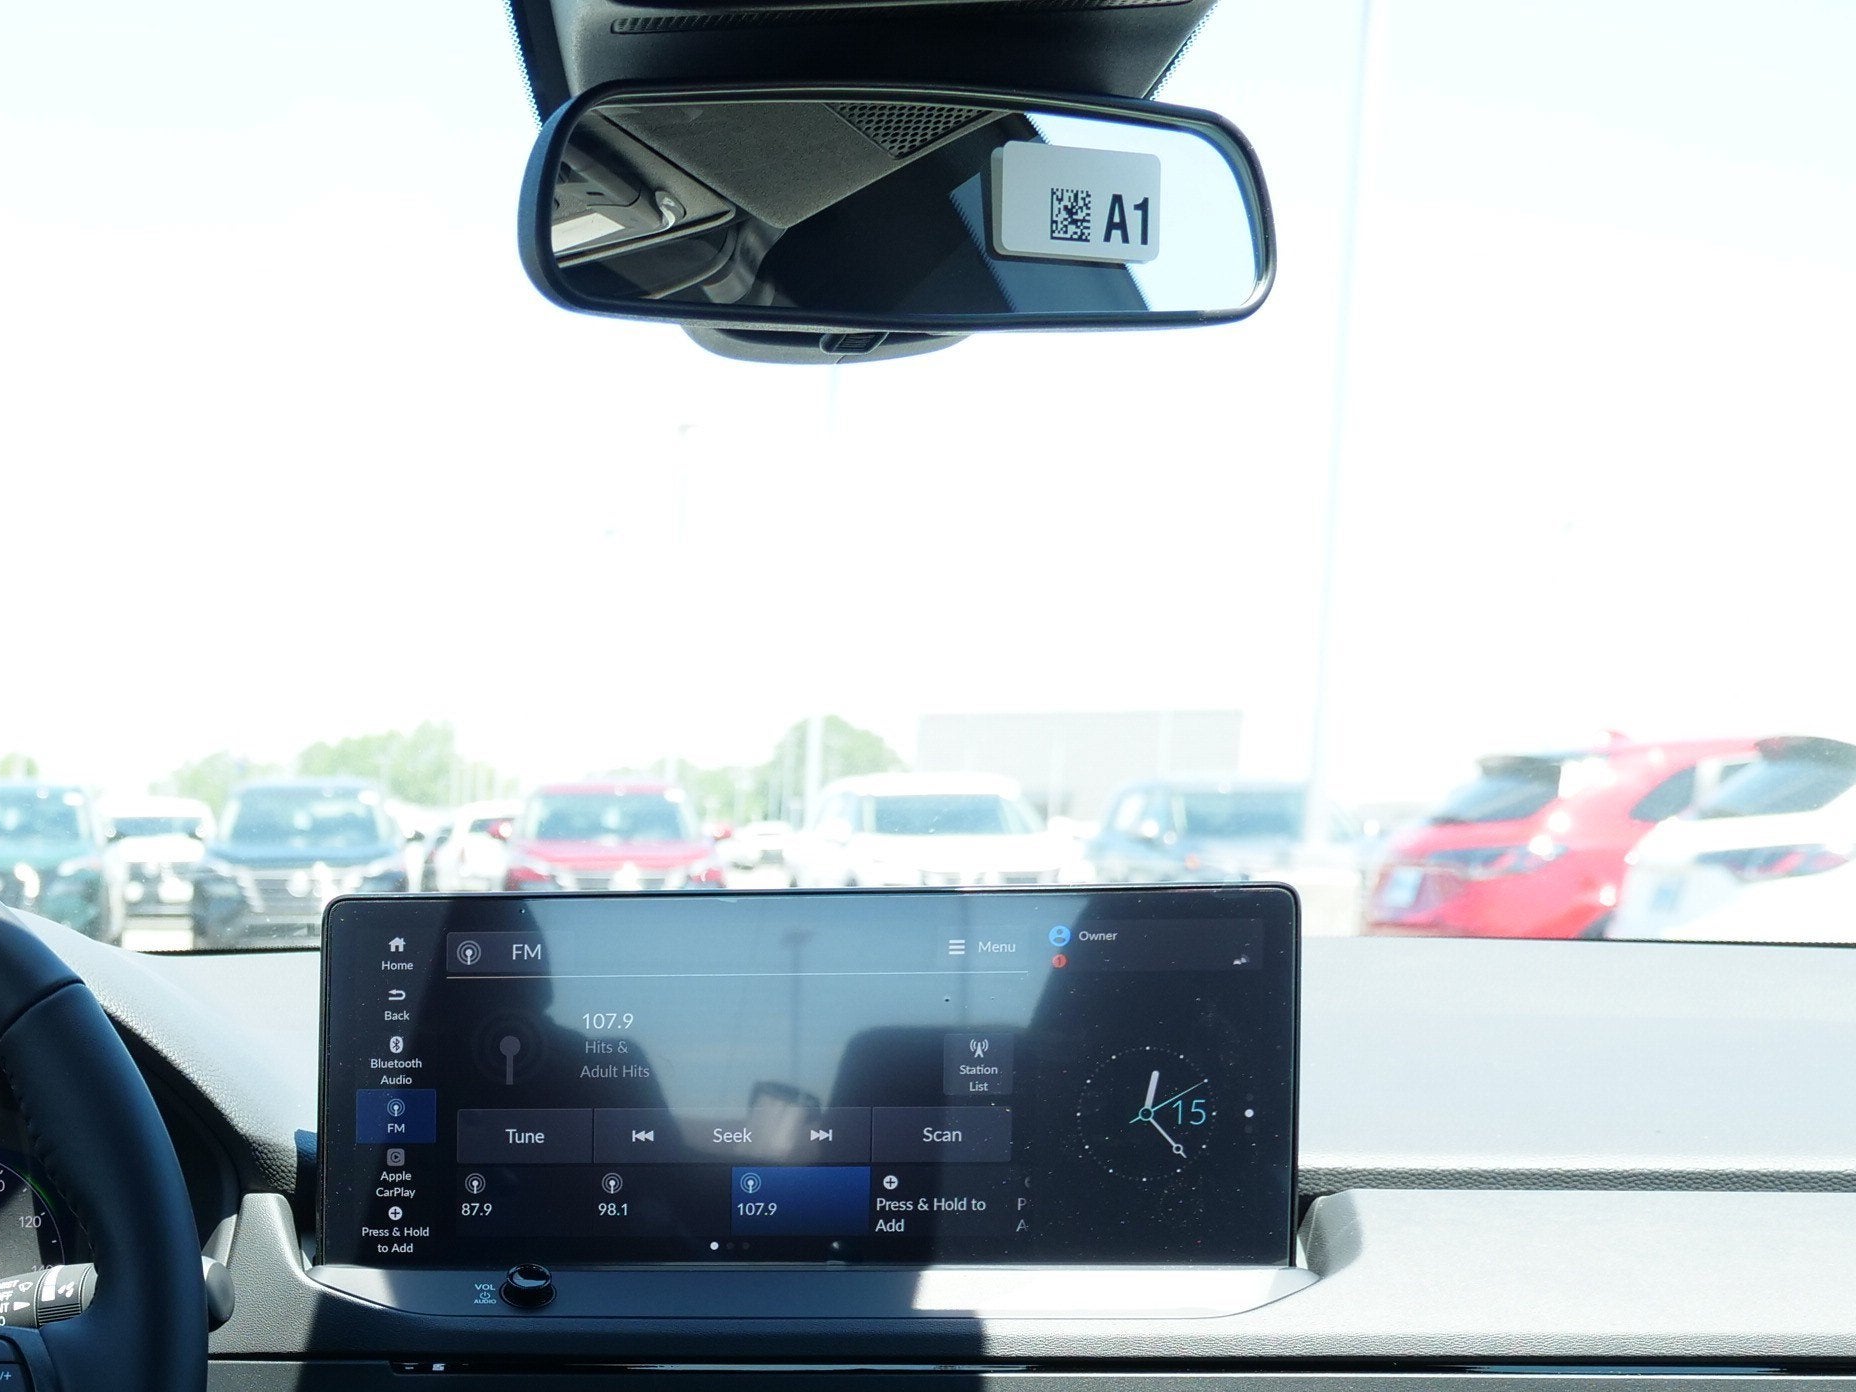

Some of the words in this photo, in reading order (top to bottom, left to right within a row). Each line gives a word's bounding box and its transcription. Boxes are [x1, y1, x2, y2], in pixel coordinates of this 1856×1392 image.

[1103, 193, 1149, 245] A1
[1078, 931, 1118, 941] Owner
[512, 944, 541, 960] FM
[978, 941, 1016, 953] Menu
[381, 961, 413, 970] Home
[384, 1011, 409, 1021] Back
[582, 1013, 634, 1029] 107.9
[585, 1041, 615, 1054] Hits
[617, 1042, 629, 1054] &
[370, 1058, 422, 1069] Bluetooth
[959, 1064, 998, 1075] Station
[580, 1065, 618, 1078] Adult
[622, 1065, 649, 1078] Hits
[380, 1075, 412, 1085] Audio
[969, 1081, 989, 1092] List
[1172, 1099, 1206, 1125] 15
[387, 1124, 405, 1133] FM
[922, 1127, 962, 1143] Scan
[506, 1129, 544, 1144] Tune
[713, 1128, 753, 1143] Seek
[380, 1171, 412, 1182] Apple
[376, 1187, 416, 1199] CarPlay
[461, 1203, 492, 1216] 87.9
[598, 1203, 628, 1216] 98.1
[737, 1203, 777, 1216] 107.9
[876, 1198, 913, 1212] Press
[918, 1199, 929, 1211] &
[933, 1197, 967, 1211] Hold
[971, 1199, 986, 1211] to
[19, 1215, 42, 1229] 120
[875, 1219, 904, 1233] Add
[362, 1227, 389, 1237] Press
[392, 1227, 401, 1237] &
[404, 1226, 429, 1237] Hold
[377, 1244, 388, 1254] to
[392, 1243, 413, 1254] Add
